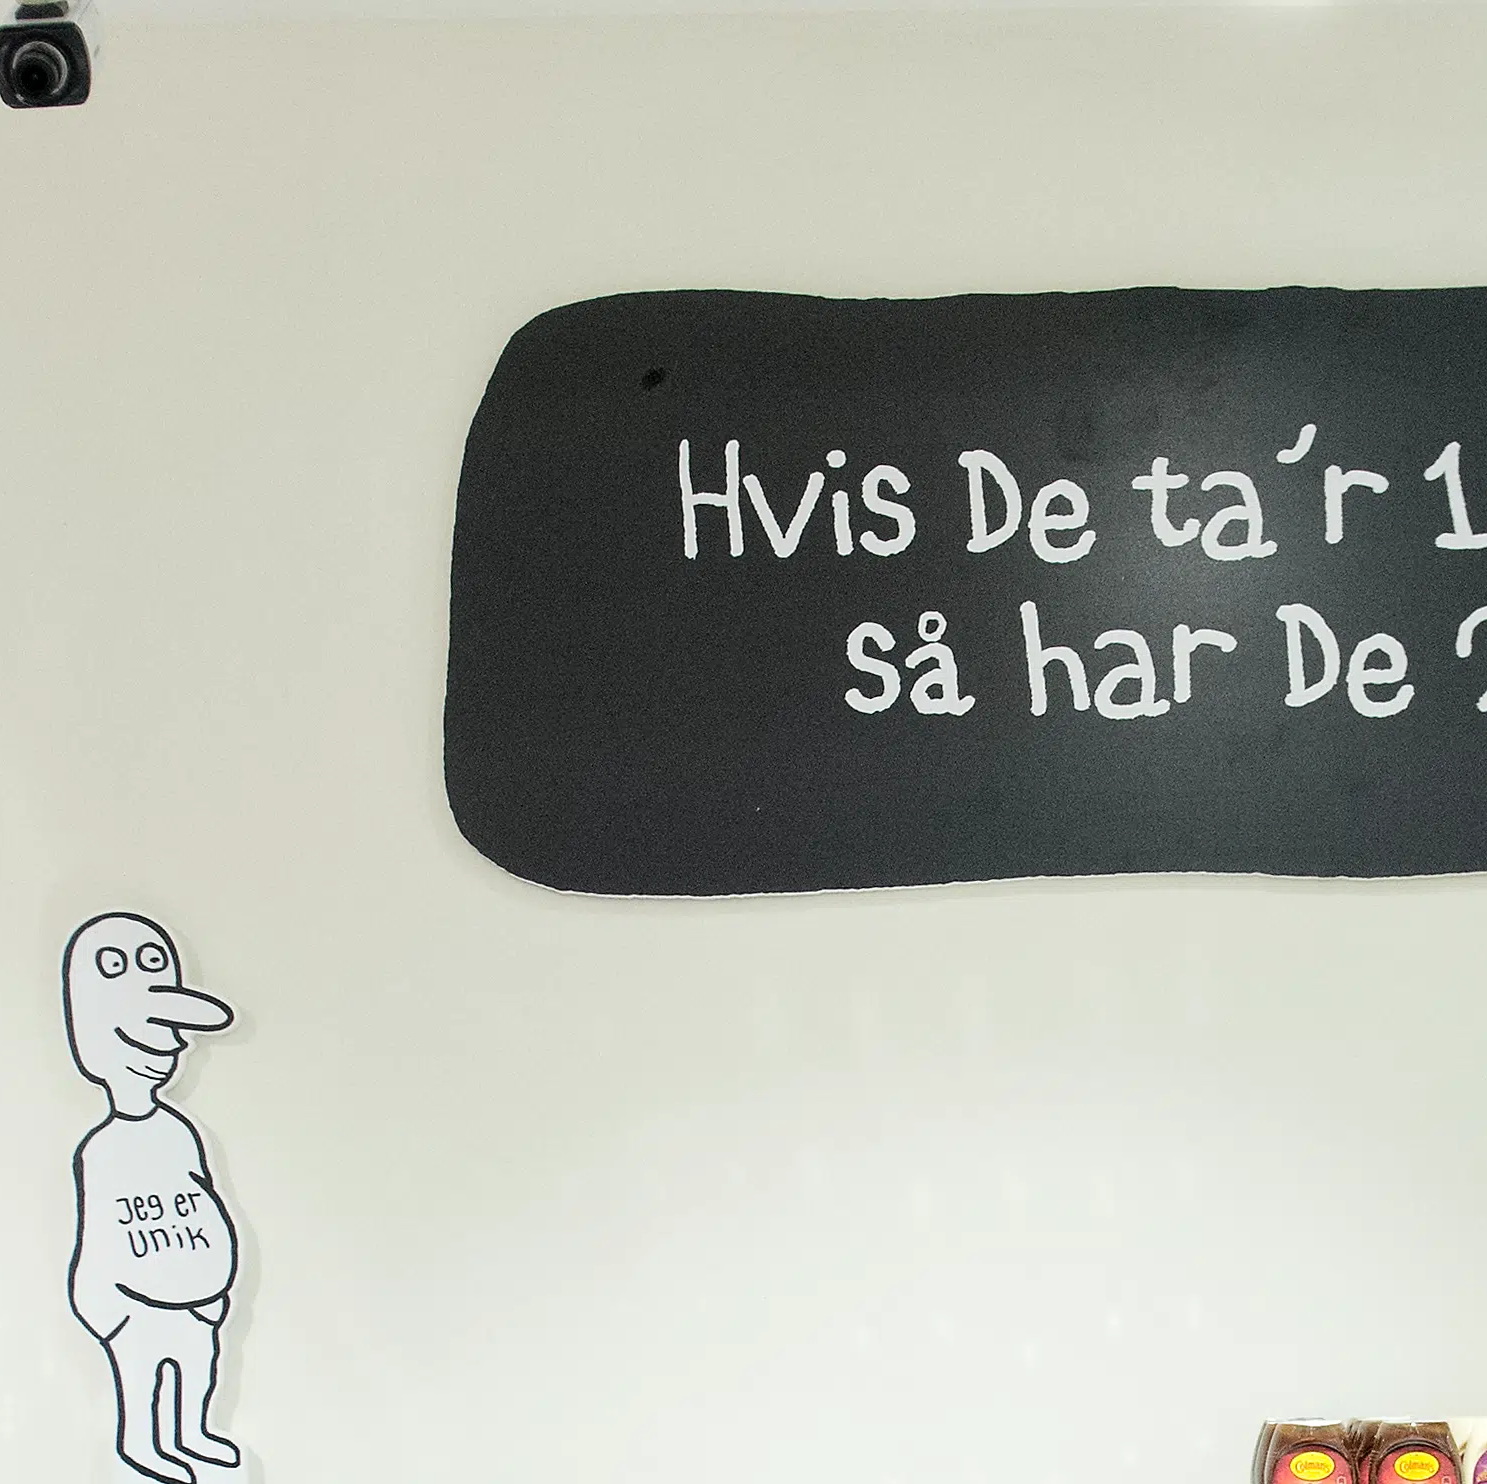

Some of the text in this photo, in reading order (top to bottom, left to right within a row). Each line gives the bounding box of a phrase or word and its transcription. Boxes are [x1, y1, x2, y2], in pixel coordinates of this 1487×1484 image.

[679, 438, 916, 560] Hvis
[958, 448, 1096, 563] De
[845, 611, 976, 717] så
[1019, 601, 1236, 719] har
[1276, 604, 1415, 718] De
[116, 1192, 201, 1225] Jeg er
[127, 1225, 210, 1258] Unik
[1295, 1459, 1333, 1474] Colman's
[1398, 1460, 1436, 1474] Colman's
